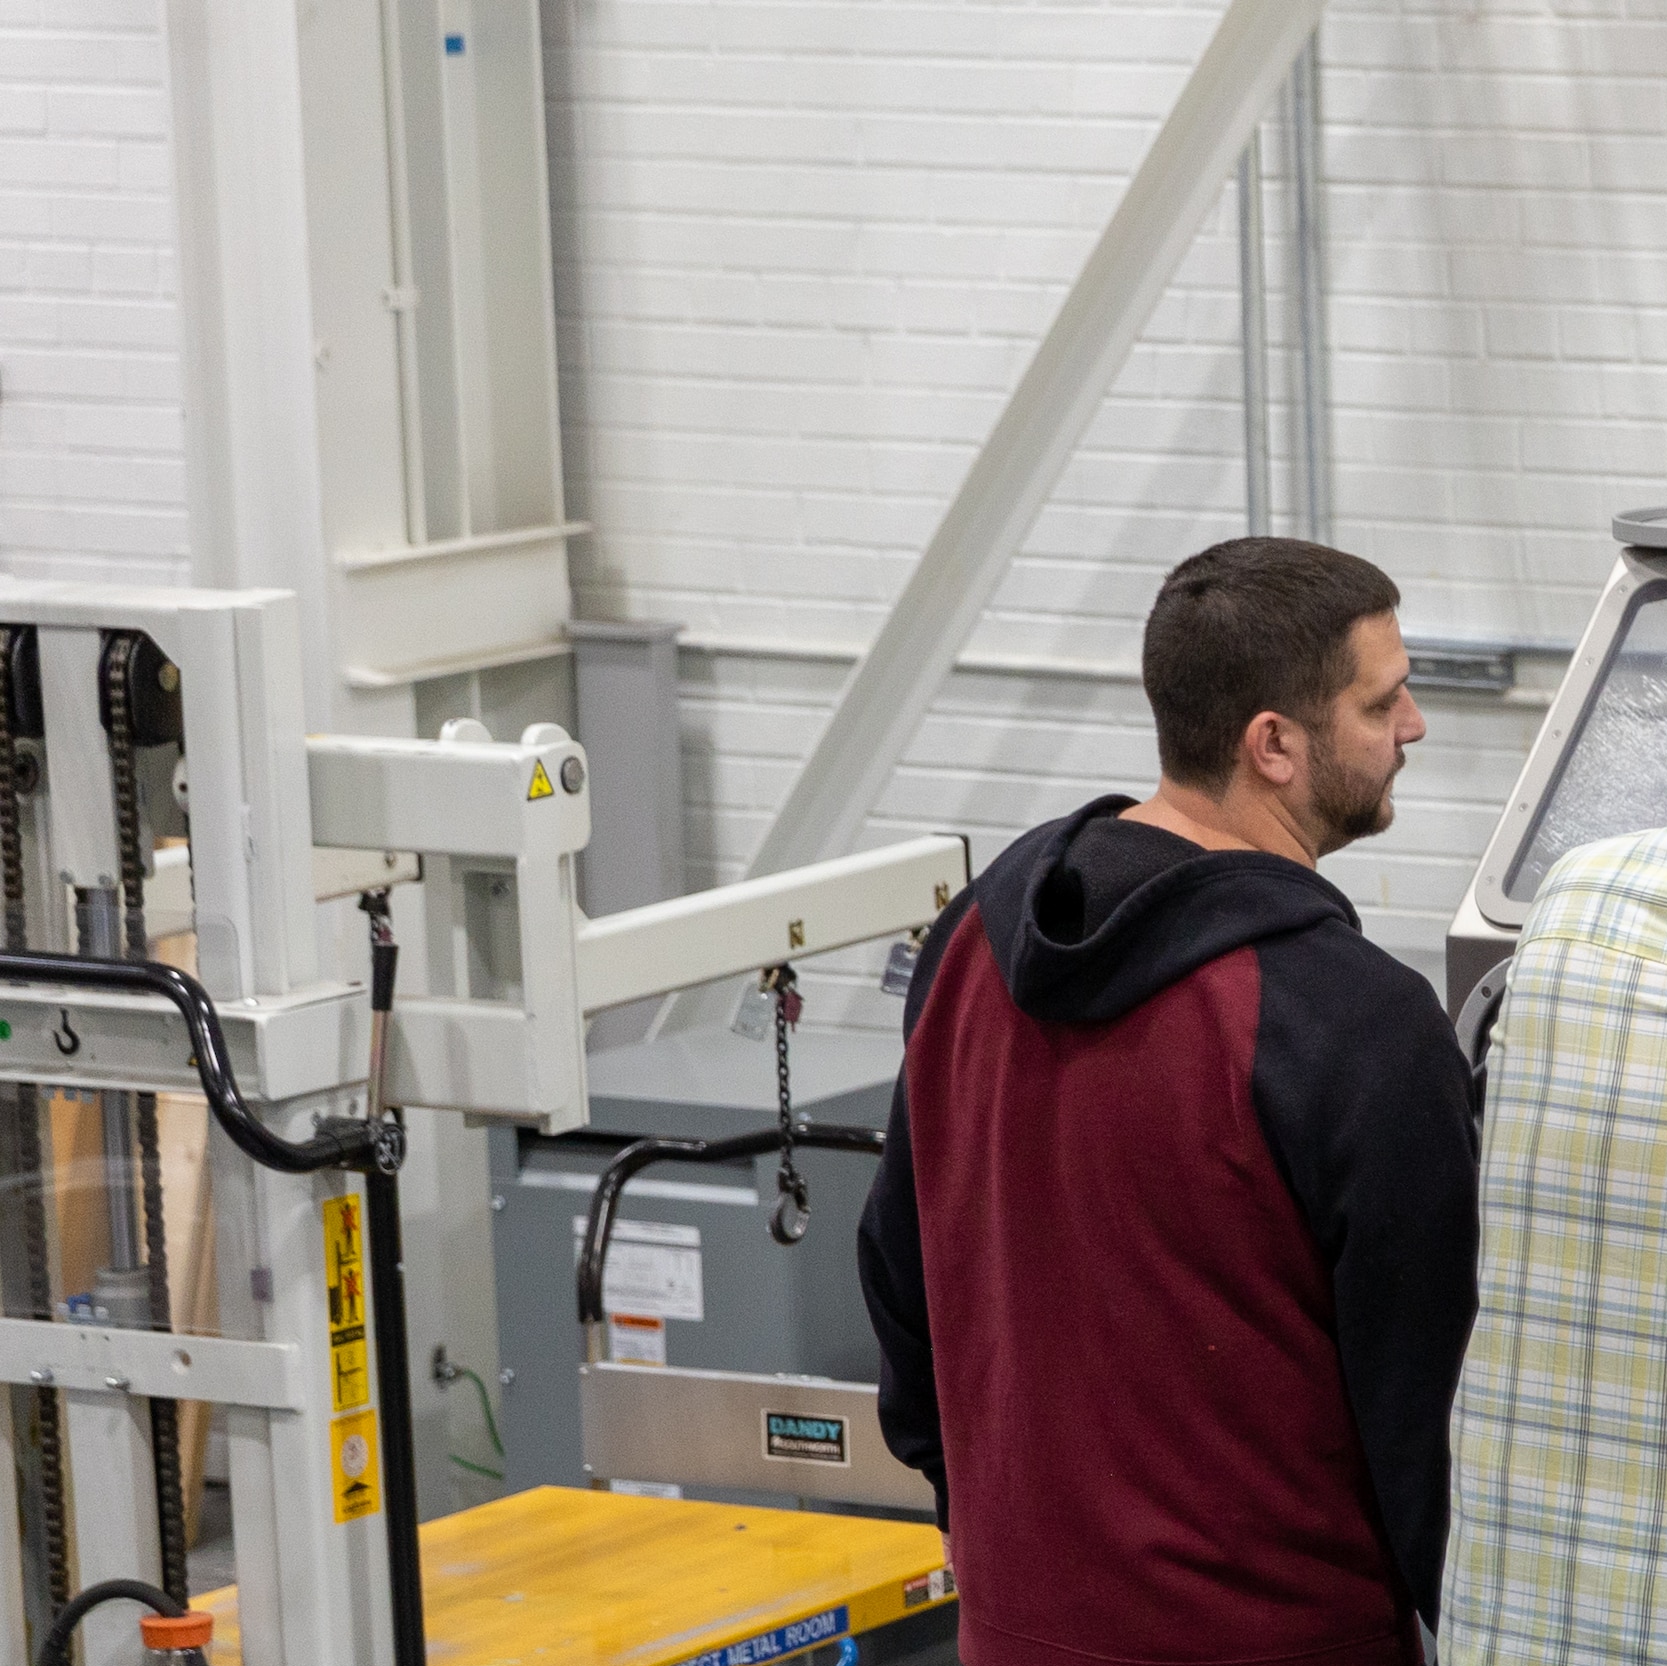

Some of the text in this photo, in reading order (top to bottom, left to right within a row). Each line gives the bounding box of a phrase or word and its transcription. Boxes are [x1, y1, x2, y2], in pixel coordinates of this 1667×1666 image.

[769, 1416, 841, 1440] DANDY
[726, 1634, 782, 1666] METAL
[785, 1612, 836, 1648] ROOM
